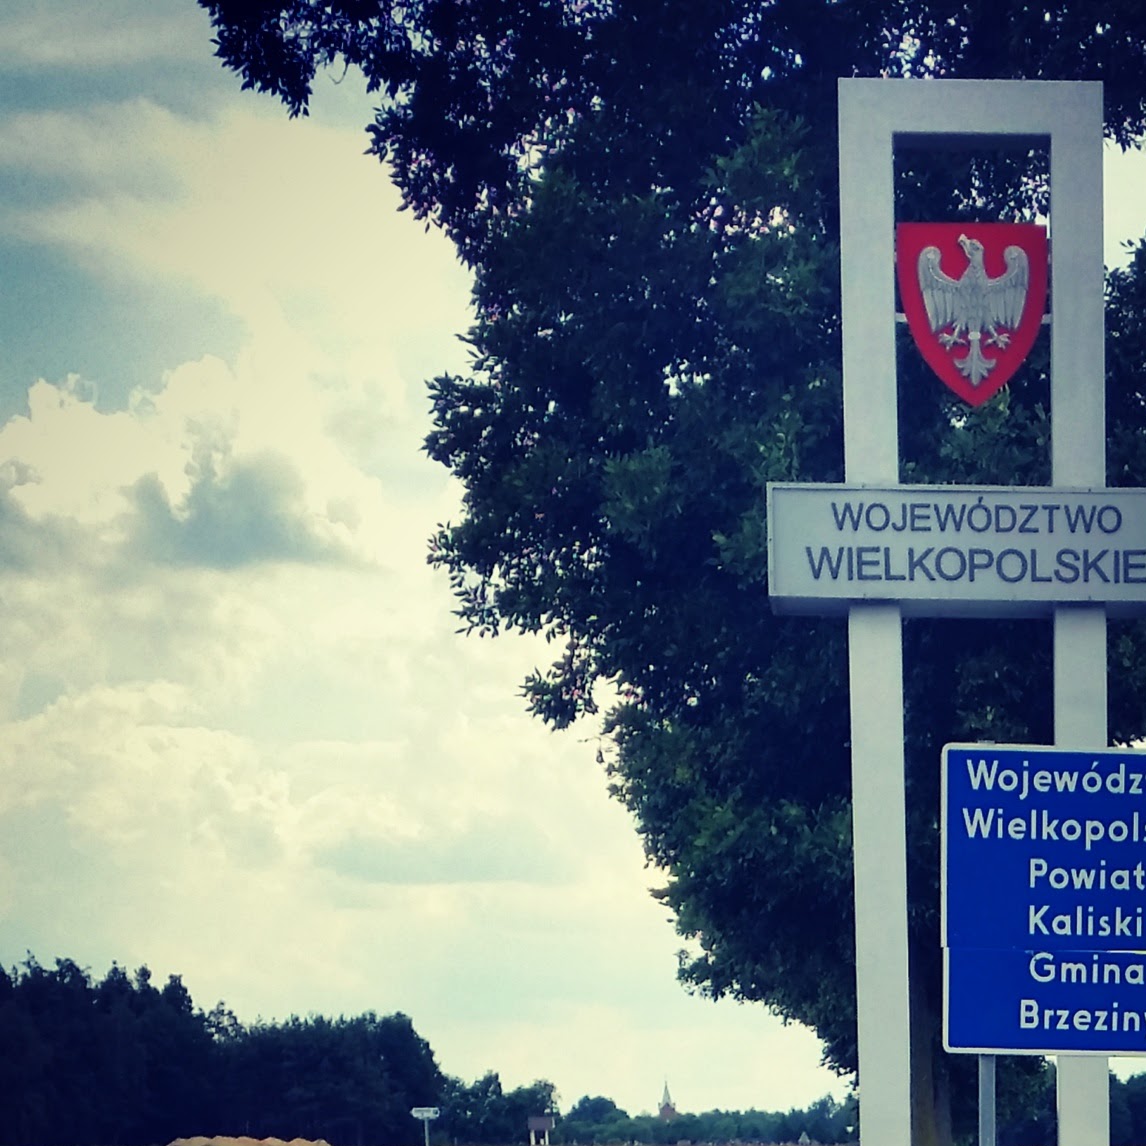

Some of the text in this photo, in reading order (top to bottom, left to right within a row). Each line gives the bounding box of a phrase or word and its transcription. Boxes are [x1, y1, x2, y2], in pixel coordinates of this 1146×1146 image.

[831, 495, 1123, 534] WOJEWÓDZTWO
[1029, 858, 1146, 891] Powiat
[1028, 905, 1143, 937] Kaliski
[1029, 952, 1145, 985] Gmina
